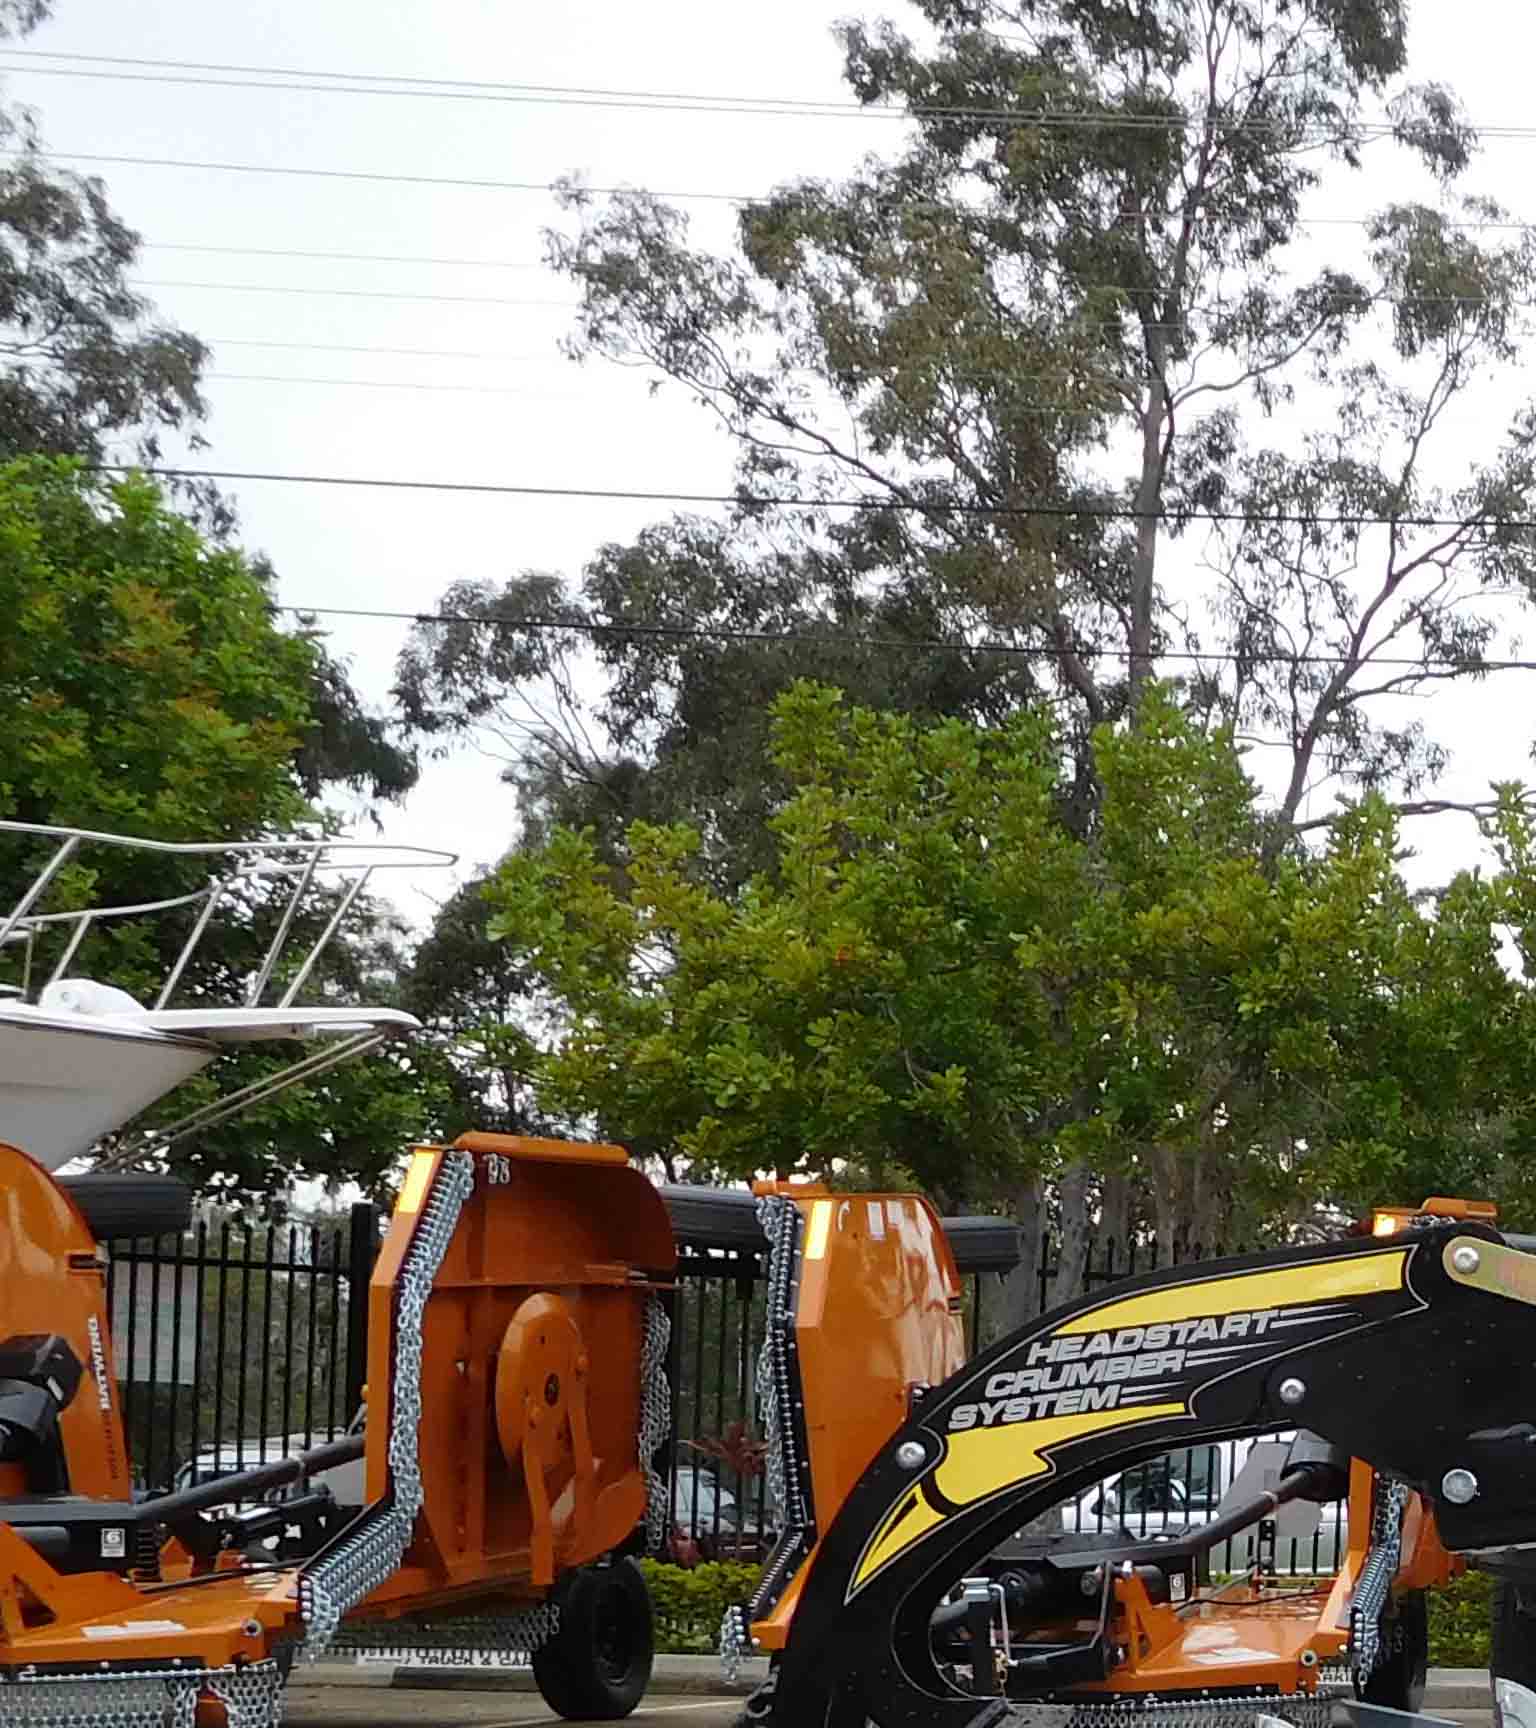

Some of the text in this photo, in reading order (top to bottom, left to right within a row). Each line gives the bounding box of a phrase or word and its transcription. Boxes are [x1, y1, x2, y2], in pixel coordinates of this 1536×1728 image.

[1025, 1309, 1281, 1367] HEADSTART
[983, 1349, 1189, 1399] CRUMBER
[948, 1383, 1122, 1430] SYSTEM
